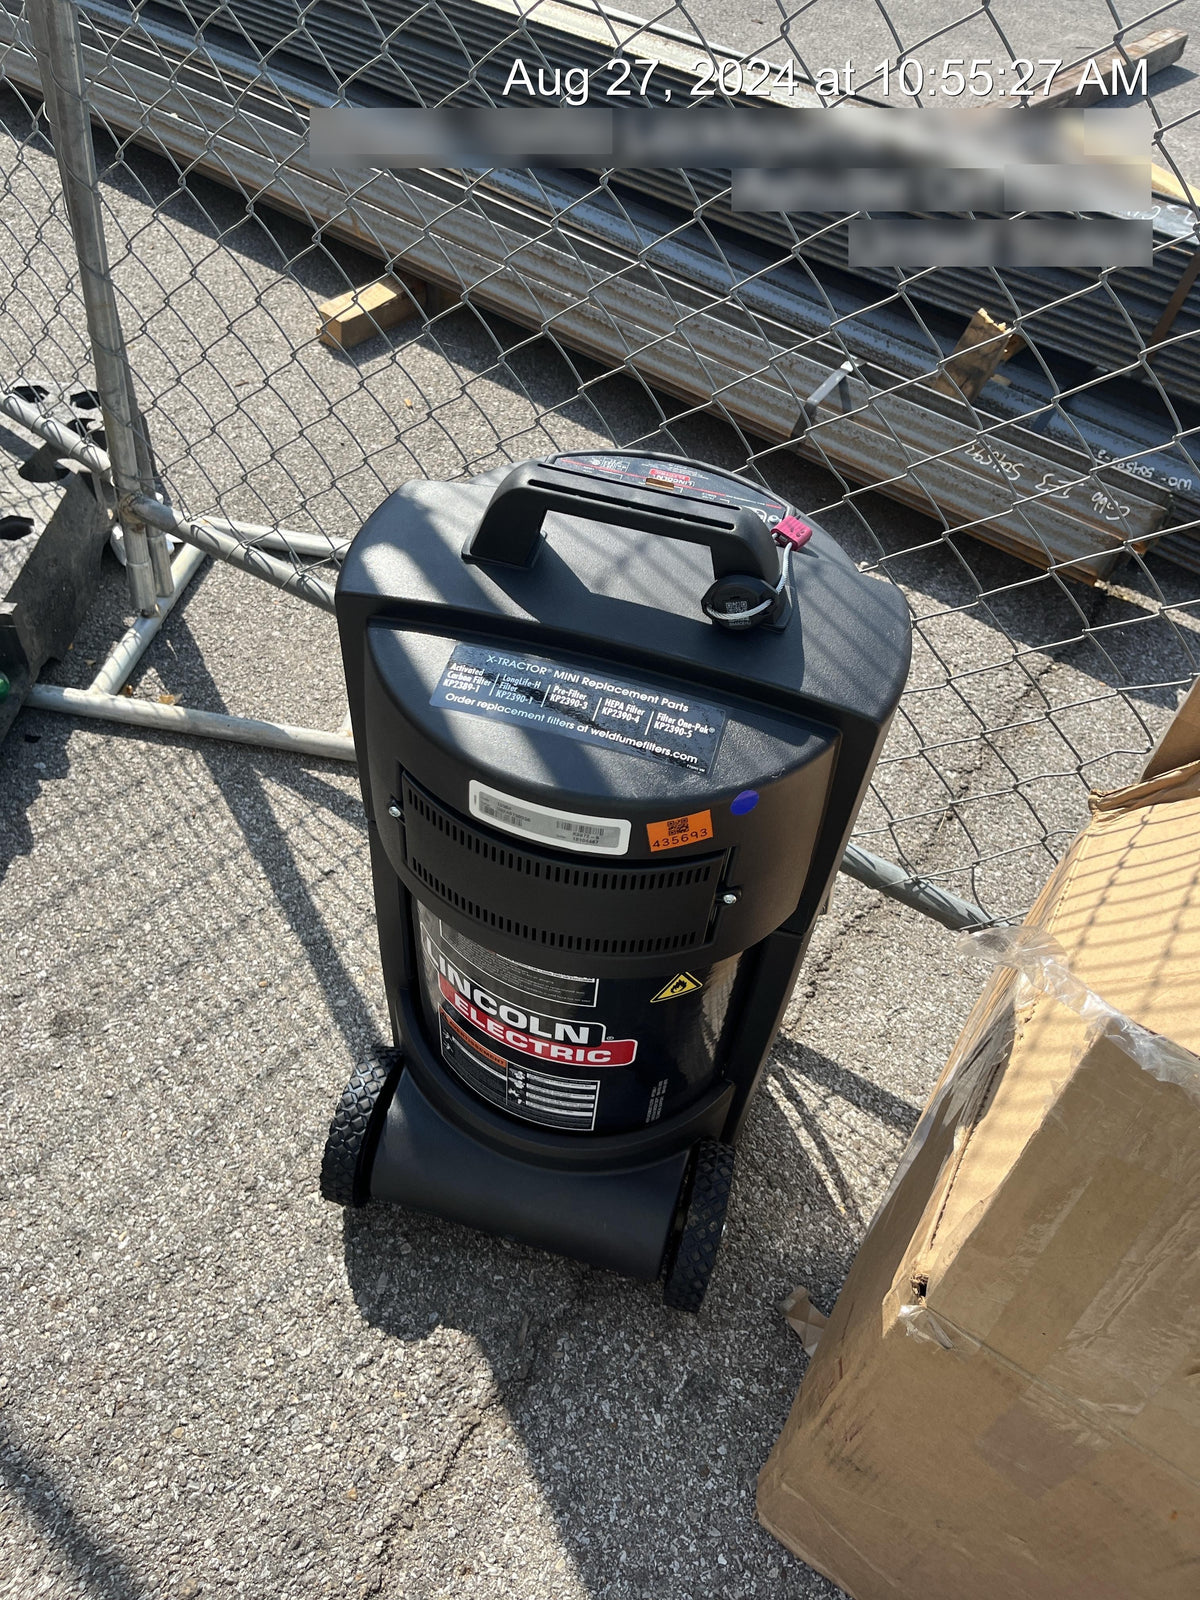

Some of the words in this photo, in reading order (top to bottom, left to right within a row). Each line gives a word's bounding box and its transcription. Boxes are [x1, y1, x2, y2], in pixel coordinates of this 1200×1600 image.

[449, 662, 486, 677] Activated
[442, 679, 481, 693] KP2389-1
[446, 670, 473, 684] Carbon
[472, 676, 492, 687] Filter
[499, 681, 518, 693] Filter
[502, 673, 542, 689] LongLife-H
[495, 689, 534, 705] KP2390-1
[552, 685, 588, 701] Pre-Filter
[553, 670, 580, 684] MINI
[581, 677, 660, 705] Replacement
[660, 697, 689, 713] Parts
[549, 693, 589, 710] KP2390-3
[604, 698, 624, 711] HEPA
[625, 703, 646, 717] Filter
[601, 706, 641, 724] KP2390-4
[656, 712, 677, 725] Filter
[445, 692, 476, 706] Order
[476, 699, 545, 722] replacement
[546, 714, 576, 730] filters
[576, 724, 589, 733] at
[590, 728, 698, 764] weldfumefilters.com
[653, 720, 693, 738] KP2390-5
[652, 828, 708, 848] 435693
[426, 935, 590, 1045] LINCOLN
[454, 992, 612, 1063] ELECTRIC
